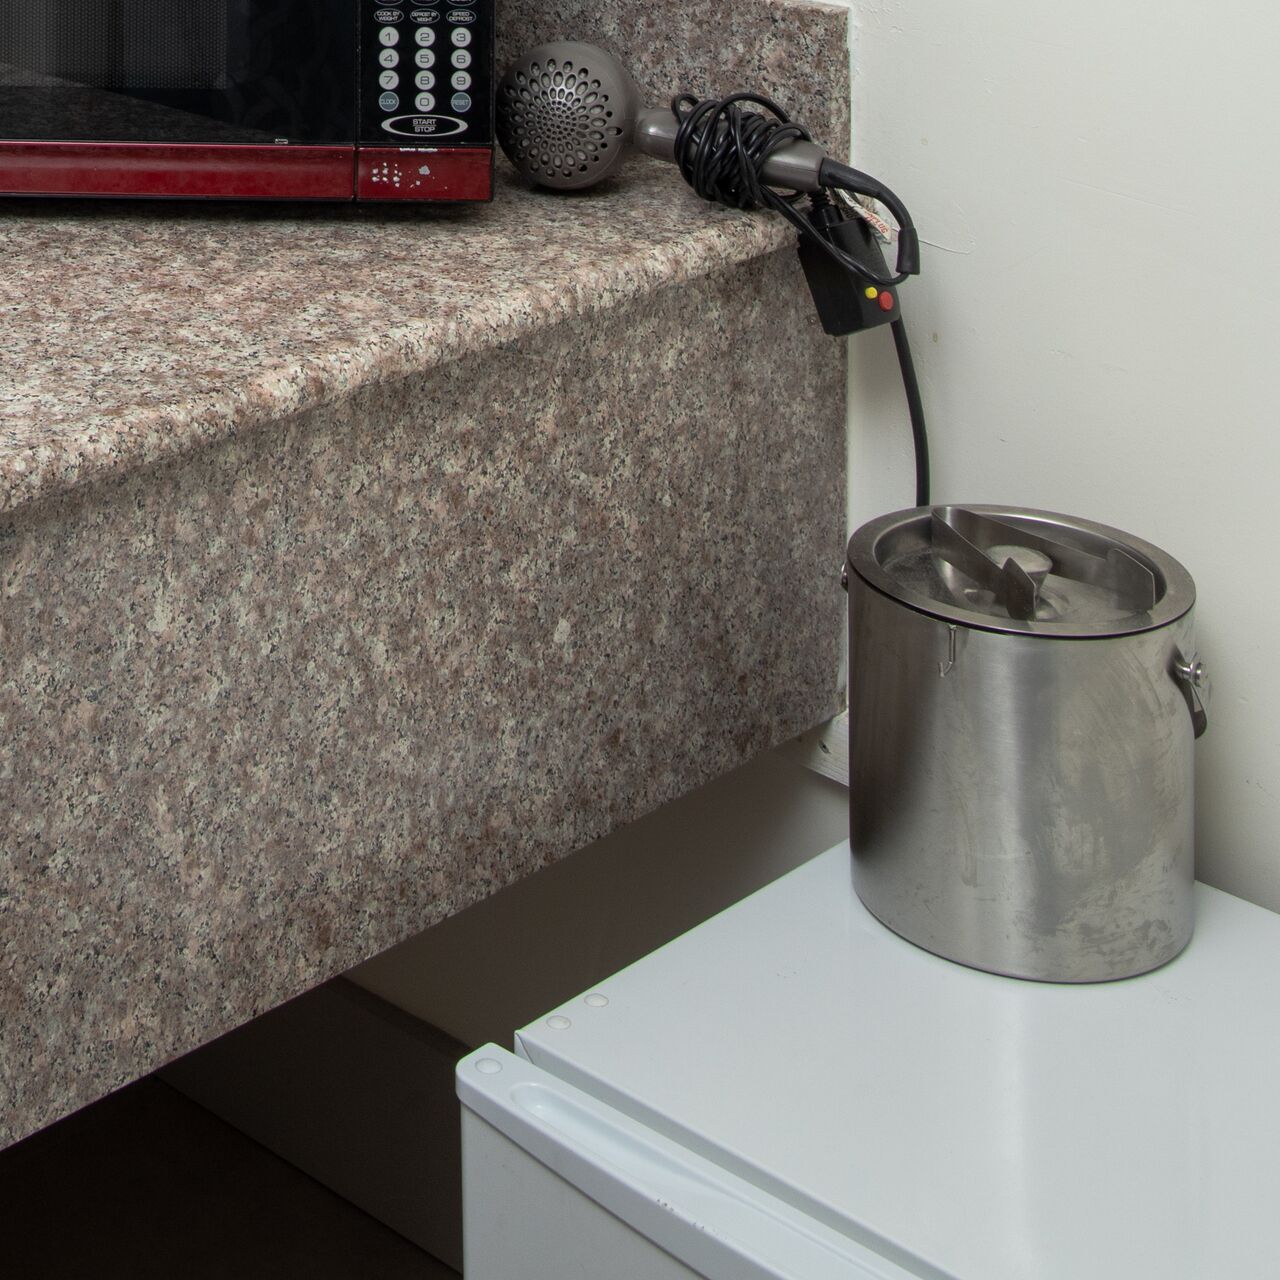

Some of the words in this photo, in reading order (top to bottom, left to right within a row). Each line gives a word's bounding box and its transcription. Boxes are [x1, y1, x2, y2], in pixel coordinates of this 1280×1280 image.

[385, 32, 391, 41] 1
[420, 32, 430, 42] 2
[456, 33, 466, 42] 3
[384, 54, 393, 63] 4
[420, 54, 430, 63] 5
[456, 54, 466, 64] 6
[384, 76, 393, 84] 7
[420, 76, 430, 85] 8
[456, 76, 466, 85] 9
[420, 97, 430, 106] 0
